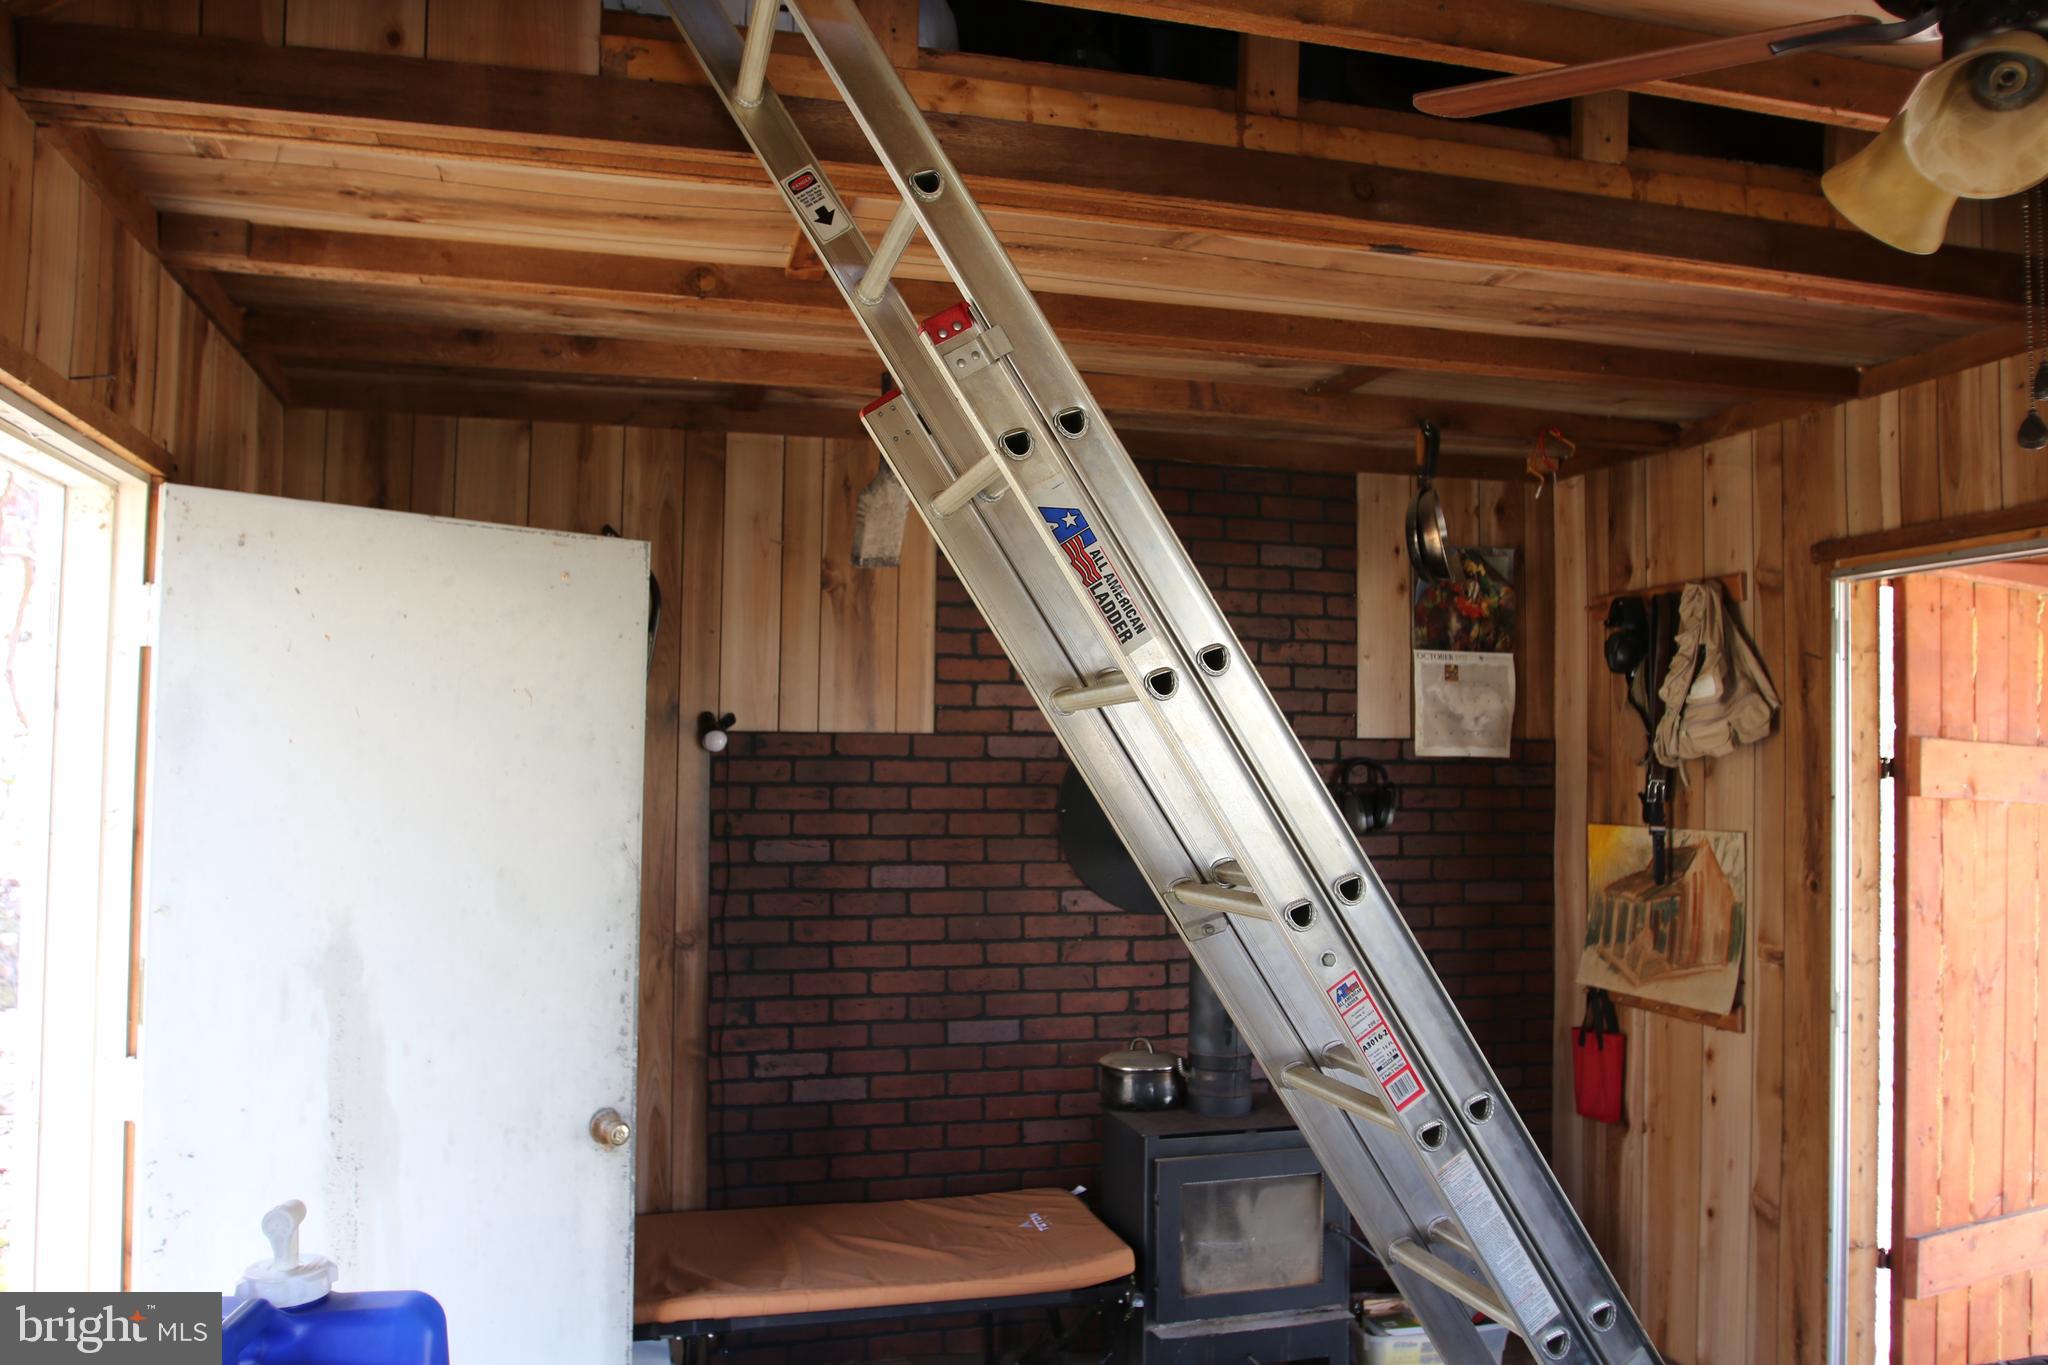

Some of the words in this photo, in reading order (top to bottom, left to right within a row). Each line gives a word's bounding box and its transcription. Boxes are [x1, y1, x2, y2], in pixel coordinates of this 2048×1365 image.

[1089, 582, 1134, 645] LADDER
[1090, 549, 1108, 572] ALL
[1103, 572, 1147, 635] AMERICAN
[1416, 652, 1454, 660] OCTOBER
[1362, 1029, 1388, 1052] A3016-2
